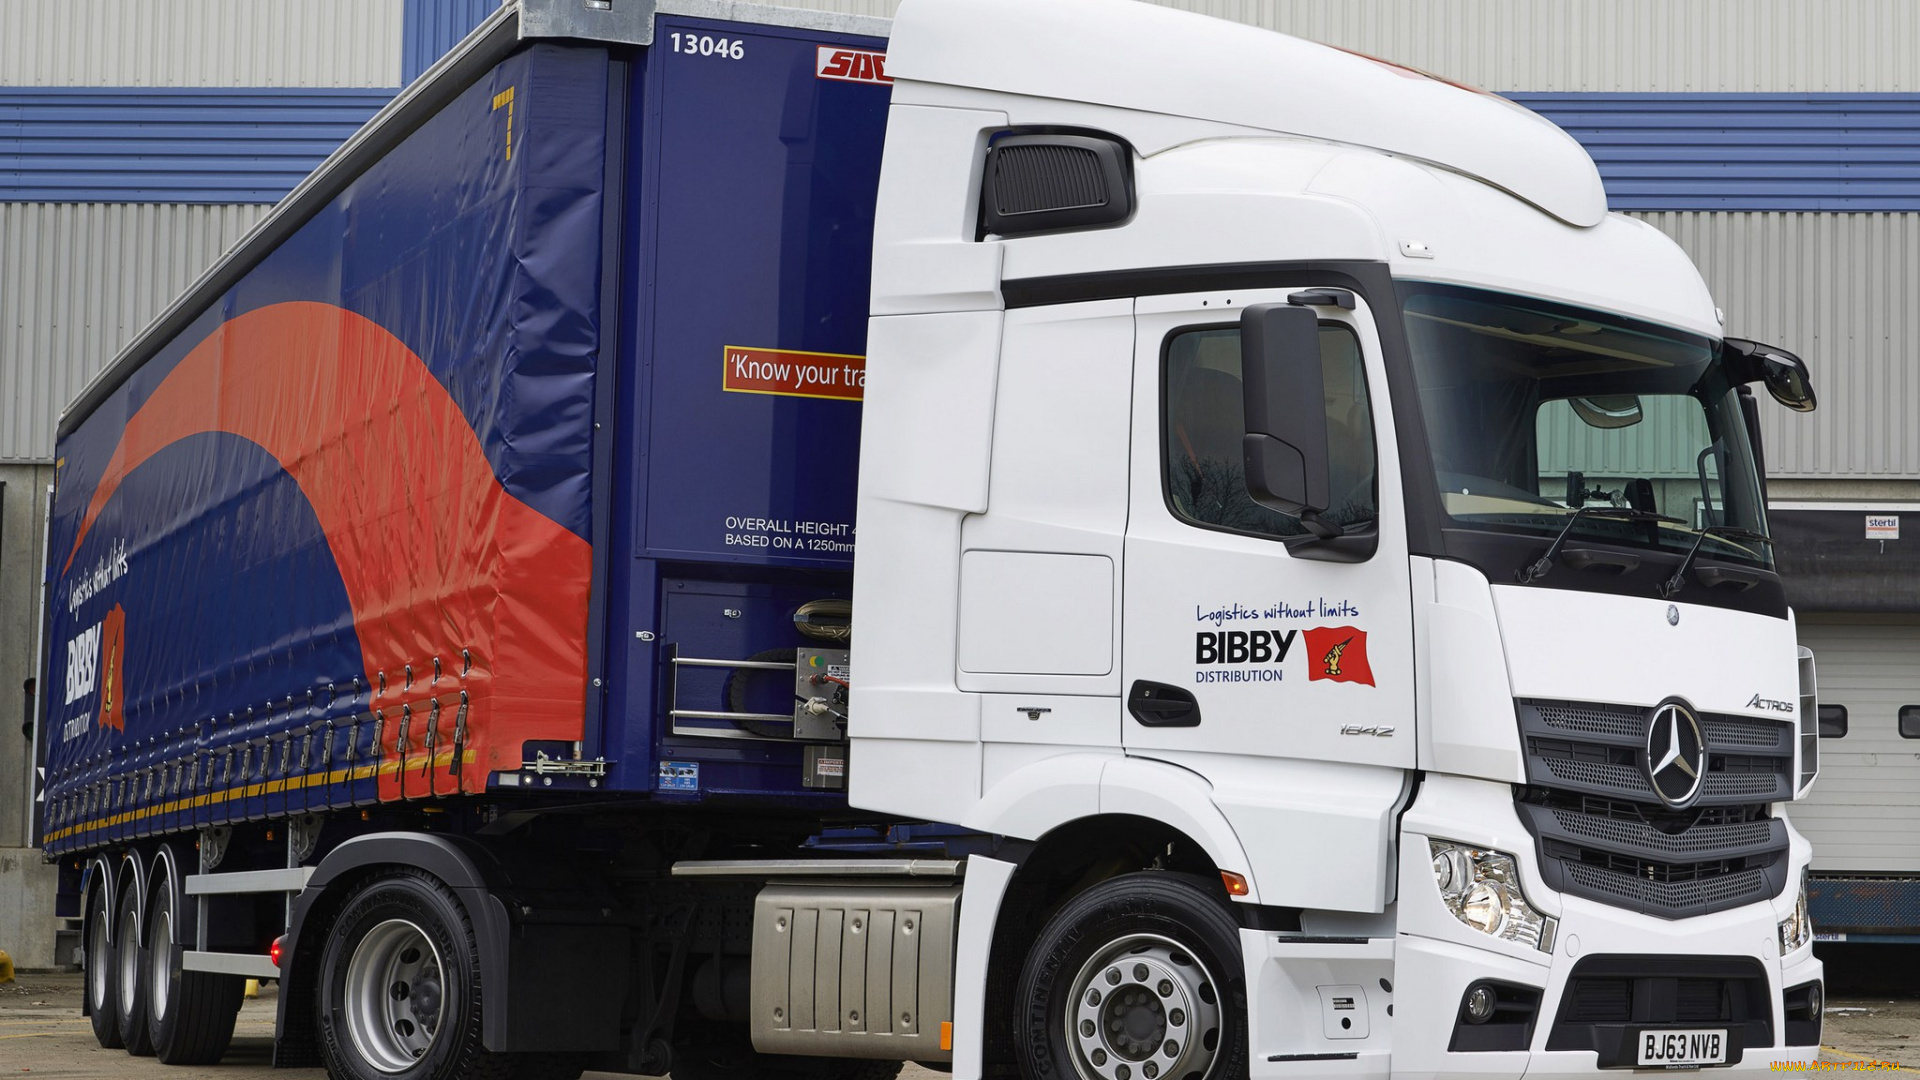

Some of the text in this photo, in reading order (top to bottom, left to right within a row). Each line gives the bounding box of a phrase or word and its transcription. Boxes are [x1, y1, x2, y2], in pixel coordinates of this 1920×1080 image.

[670, 32, 744, 60] 13046
[795, 364, 839, 389] your
[725, 516, 792, 533] OVERALL
[795, 521, 849, 536] HEIGHT
[1869, 518, 1896, 527] stertil
[725, 533, 856, 553] BASED ON A 1250mm
[1197, 597, 1359, 627] Logistics without limits
[1196, 630, 1298, 664] BIBBY
[65, 621, 102, 706] BIBBY
[1196, 669, 1283, 683] DISTRIBUTION
[1339, 722, 1396, 738] 1842
[1645, 1034, 1720, 1060] BJ63 NVB
